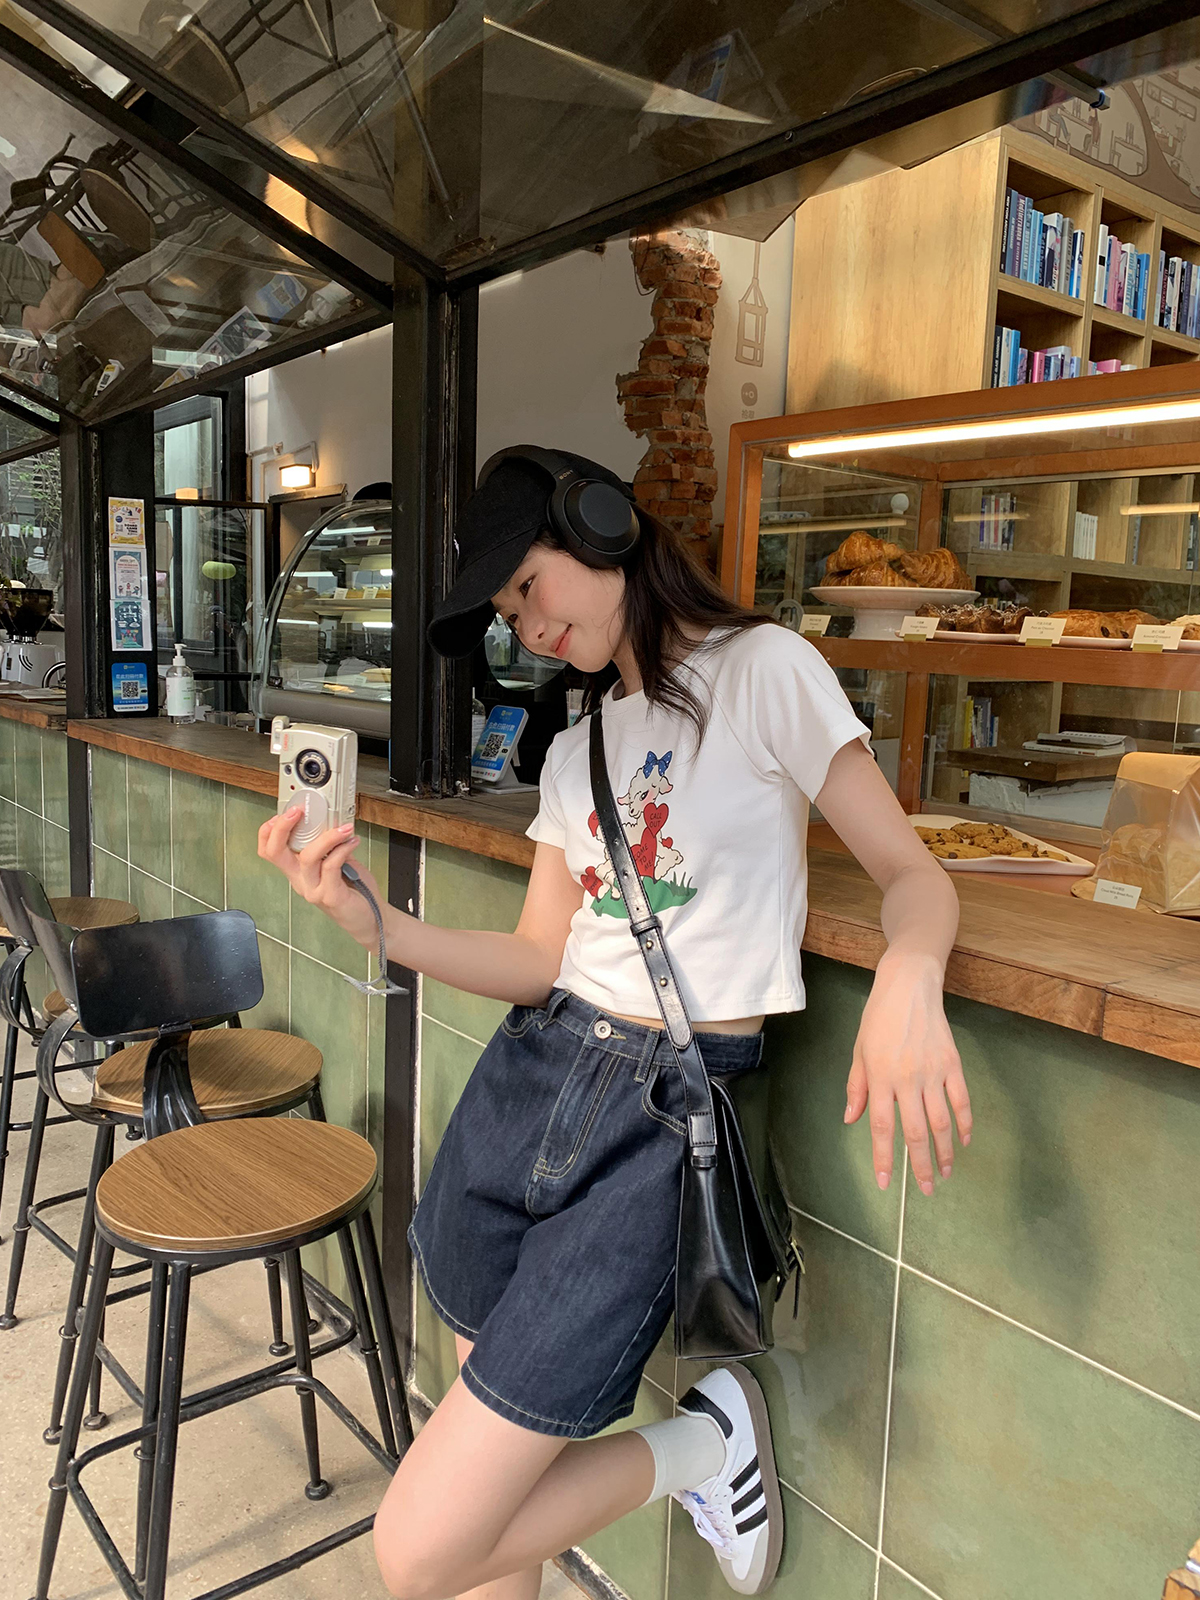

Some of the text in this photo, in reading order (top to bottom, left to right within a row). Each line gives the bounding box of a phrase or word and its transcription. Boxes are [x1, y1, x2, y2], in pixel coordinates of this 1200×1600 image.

[559, 469, 573, 480] SONY
[650, 812, 663, 821] CALL
[650, 820, 661, 828] OUT
[639, 855, 647, 866] TO
